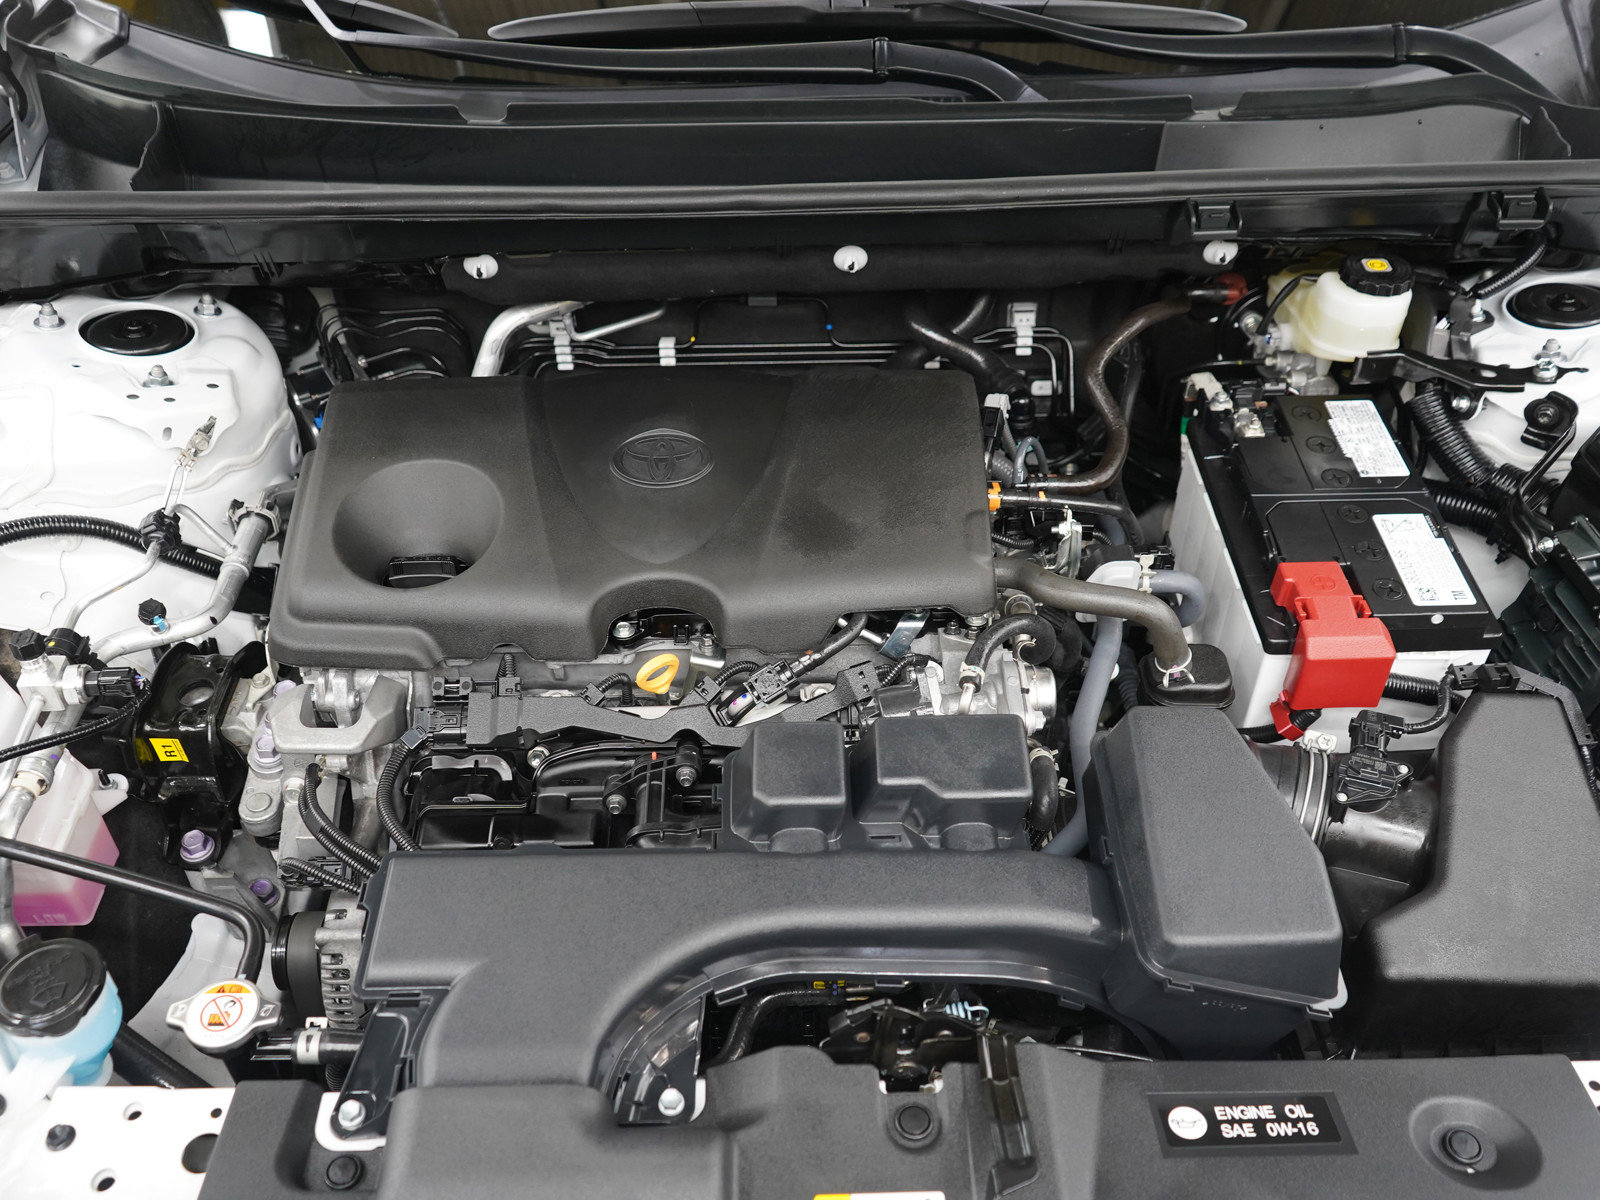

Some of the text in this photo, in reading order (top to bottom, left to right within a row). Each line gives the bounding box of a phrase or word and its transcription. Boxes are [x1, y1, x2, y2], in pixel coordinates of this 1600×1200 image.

[161, 745, 177, 757] R1
[1213, 1104, 1314, 1120] ENGINE OIL
[1220, 1121, 1319, 1138] SAE 0W-16
